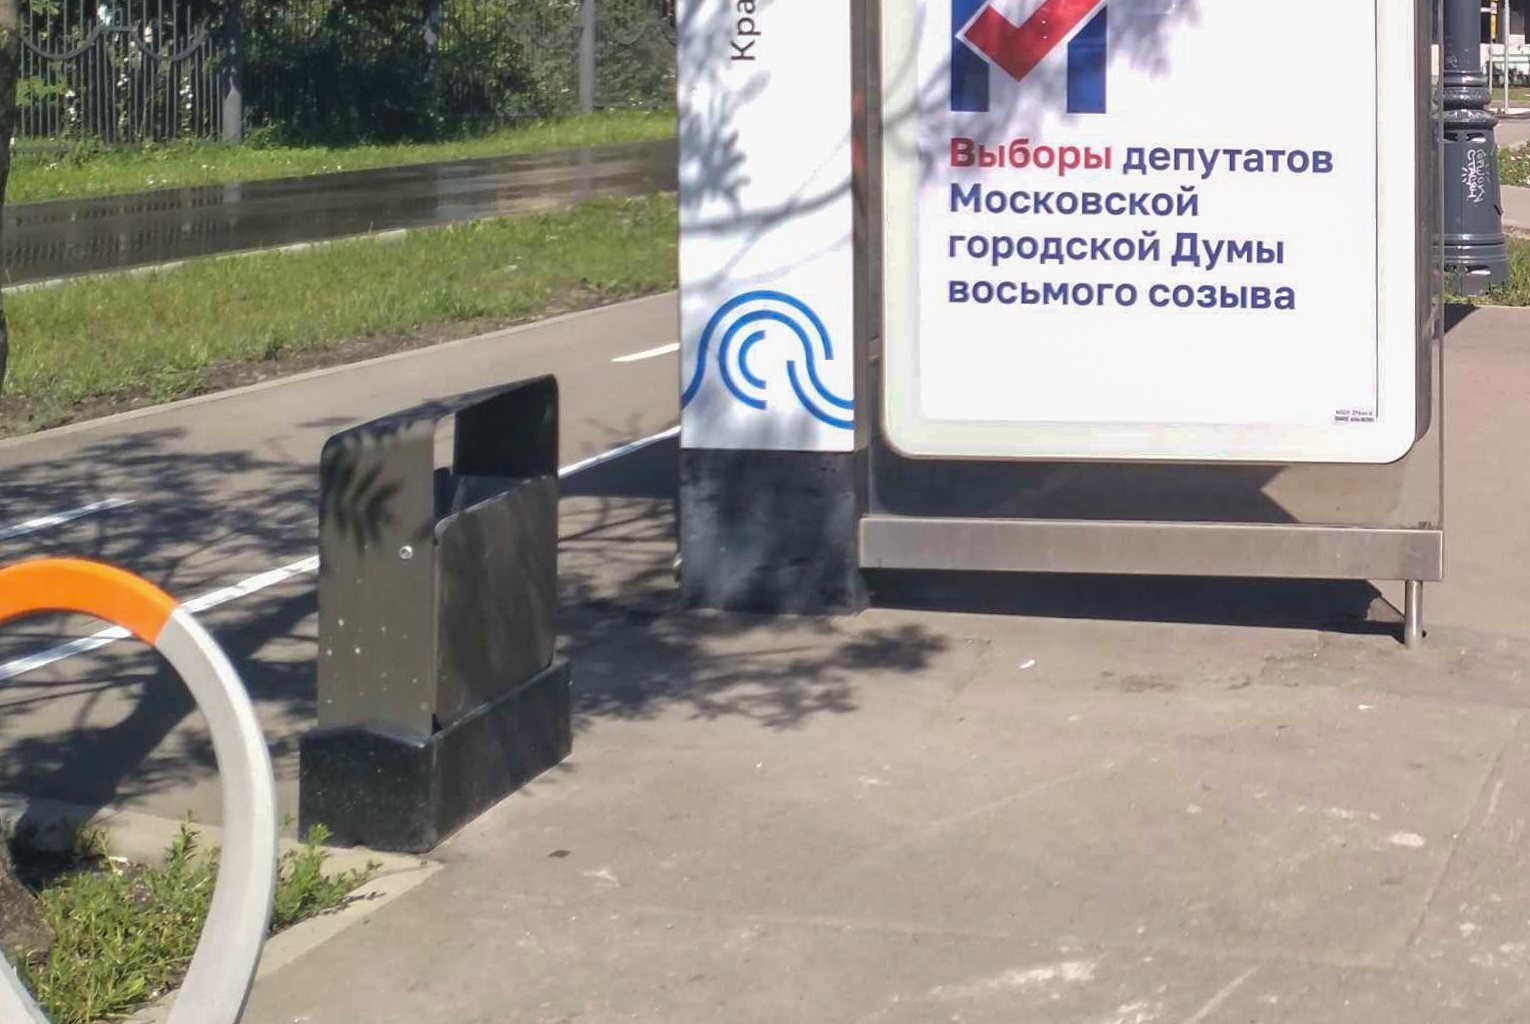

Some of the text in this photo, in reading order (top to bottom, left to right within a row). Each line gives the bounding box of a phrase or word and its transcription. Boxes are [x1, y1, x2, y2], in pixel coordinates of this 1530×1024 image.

[949, 137, 1334, 179] Выборы депутатов
[949, 183, 1200, 216] Московской
[948, 230, 1285, 271] городской Думы
[948, 280, 1296, 310] восьмого созыва
